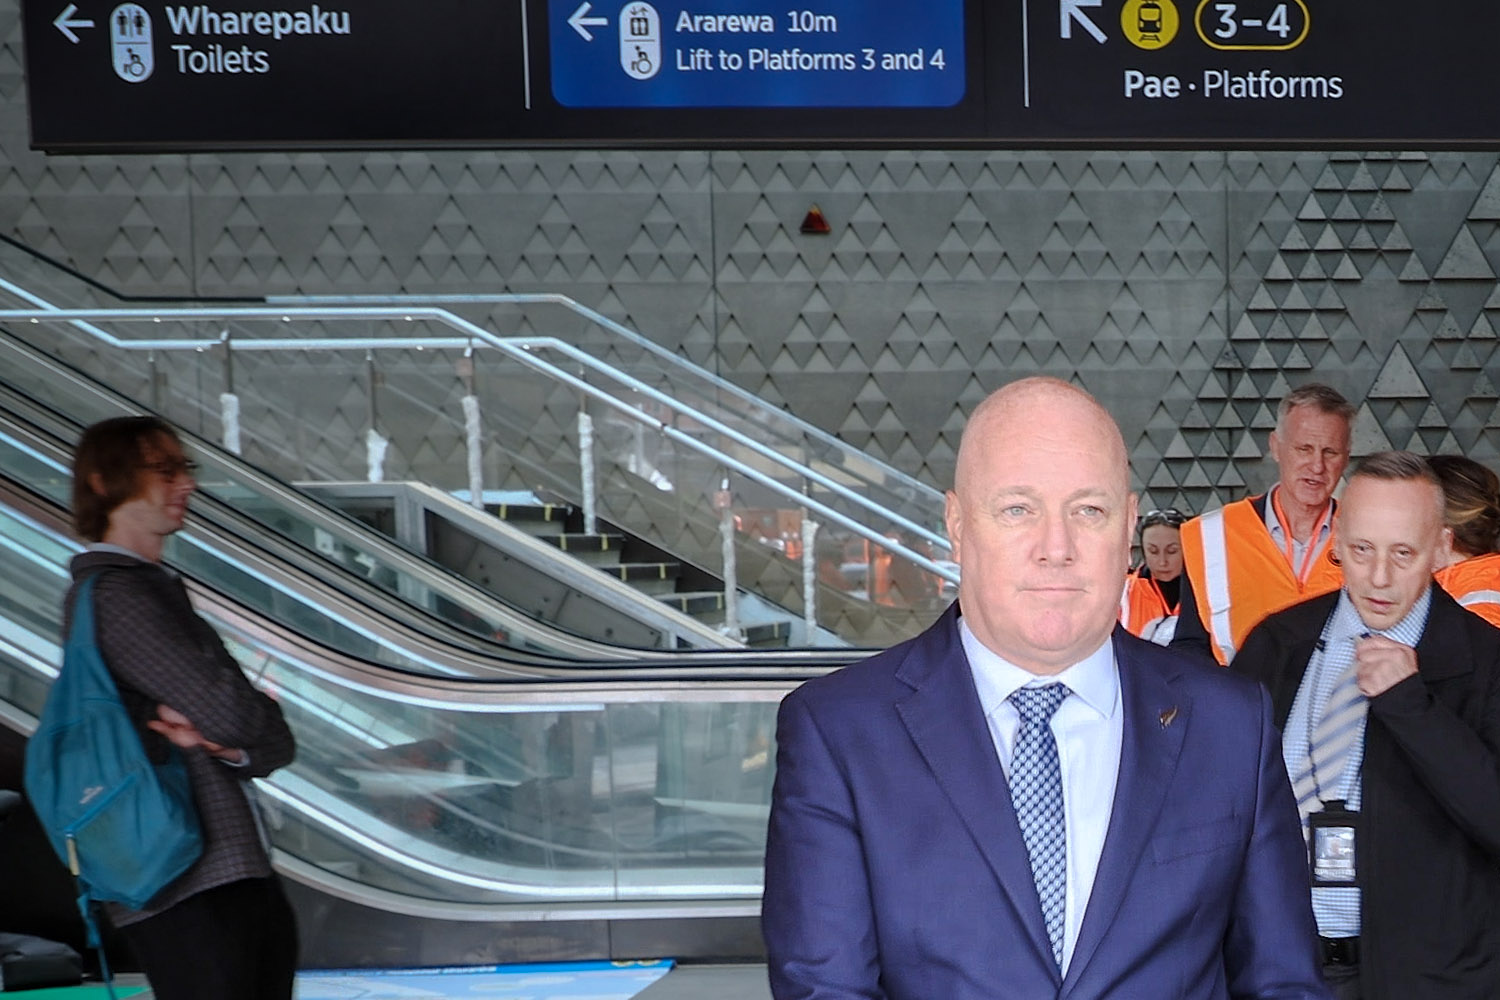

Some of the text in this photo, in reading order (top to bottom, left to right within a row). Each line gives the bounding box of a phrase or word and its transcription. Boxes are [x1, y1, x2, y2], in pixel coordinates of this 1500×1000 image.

[165, 4, 350, 40] Wharepaku
[675, 10, 837, 33] Ararewa 10m
[1214, 4, 1291, 38] 3-4
[171, 44, 269, 74] Toilets
[676, 48, 946, 71] Lift to Platforms 3 and 4
[1124, 69, 1343, 99] Pae Platforms
